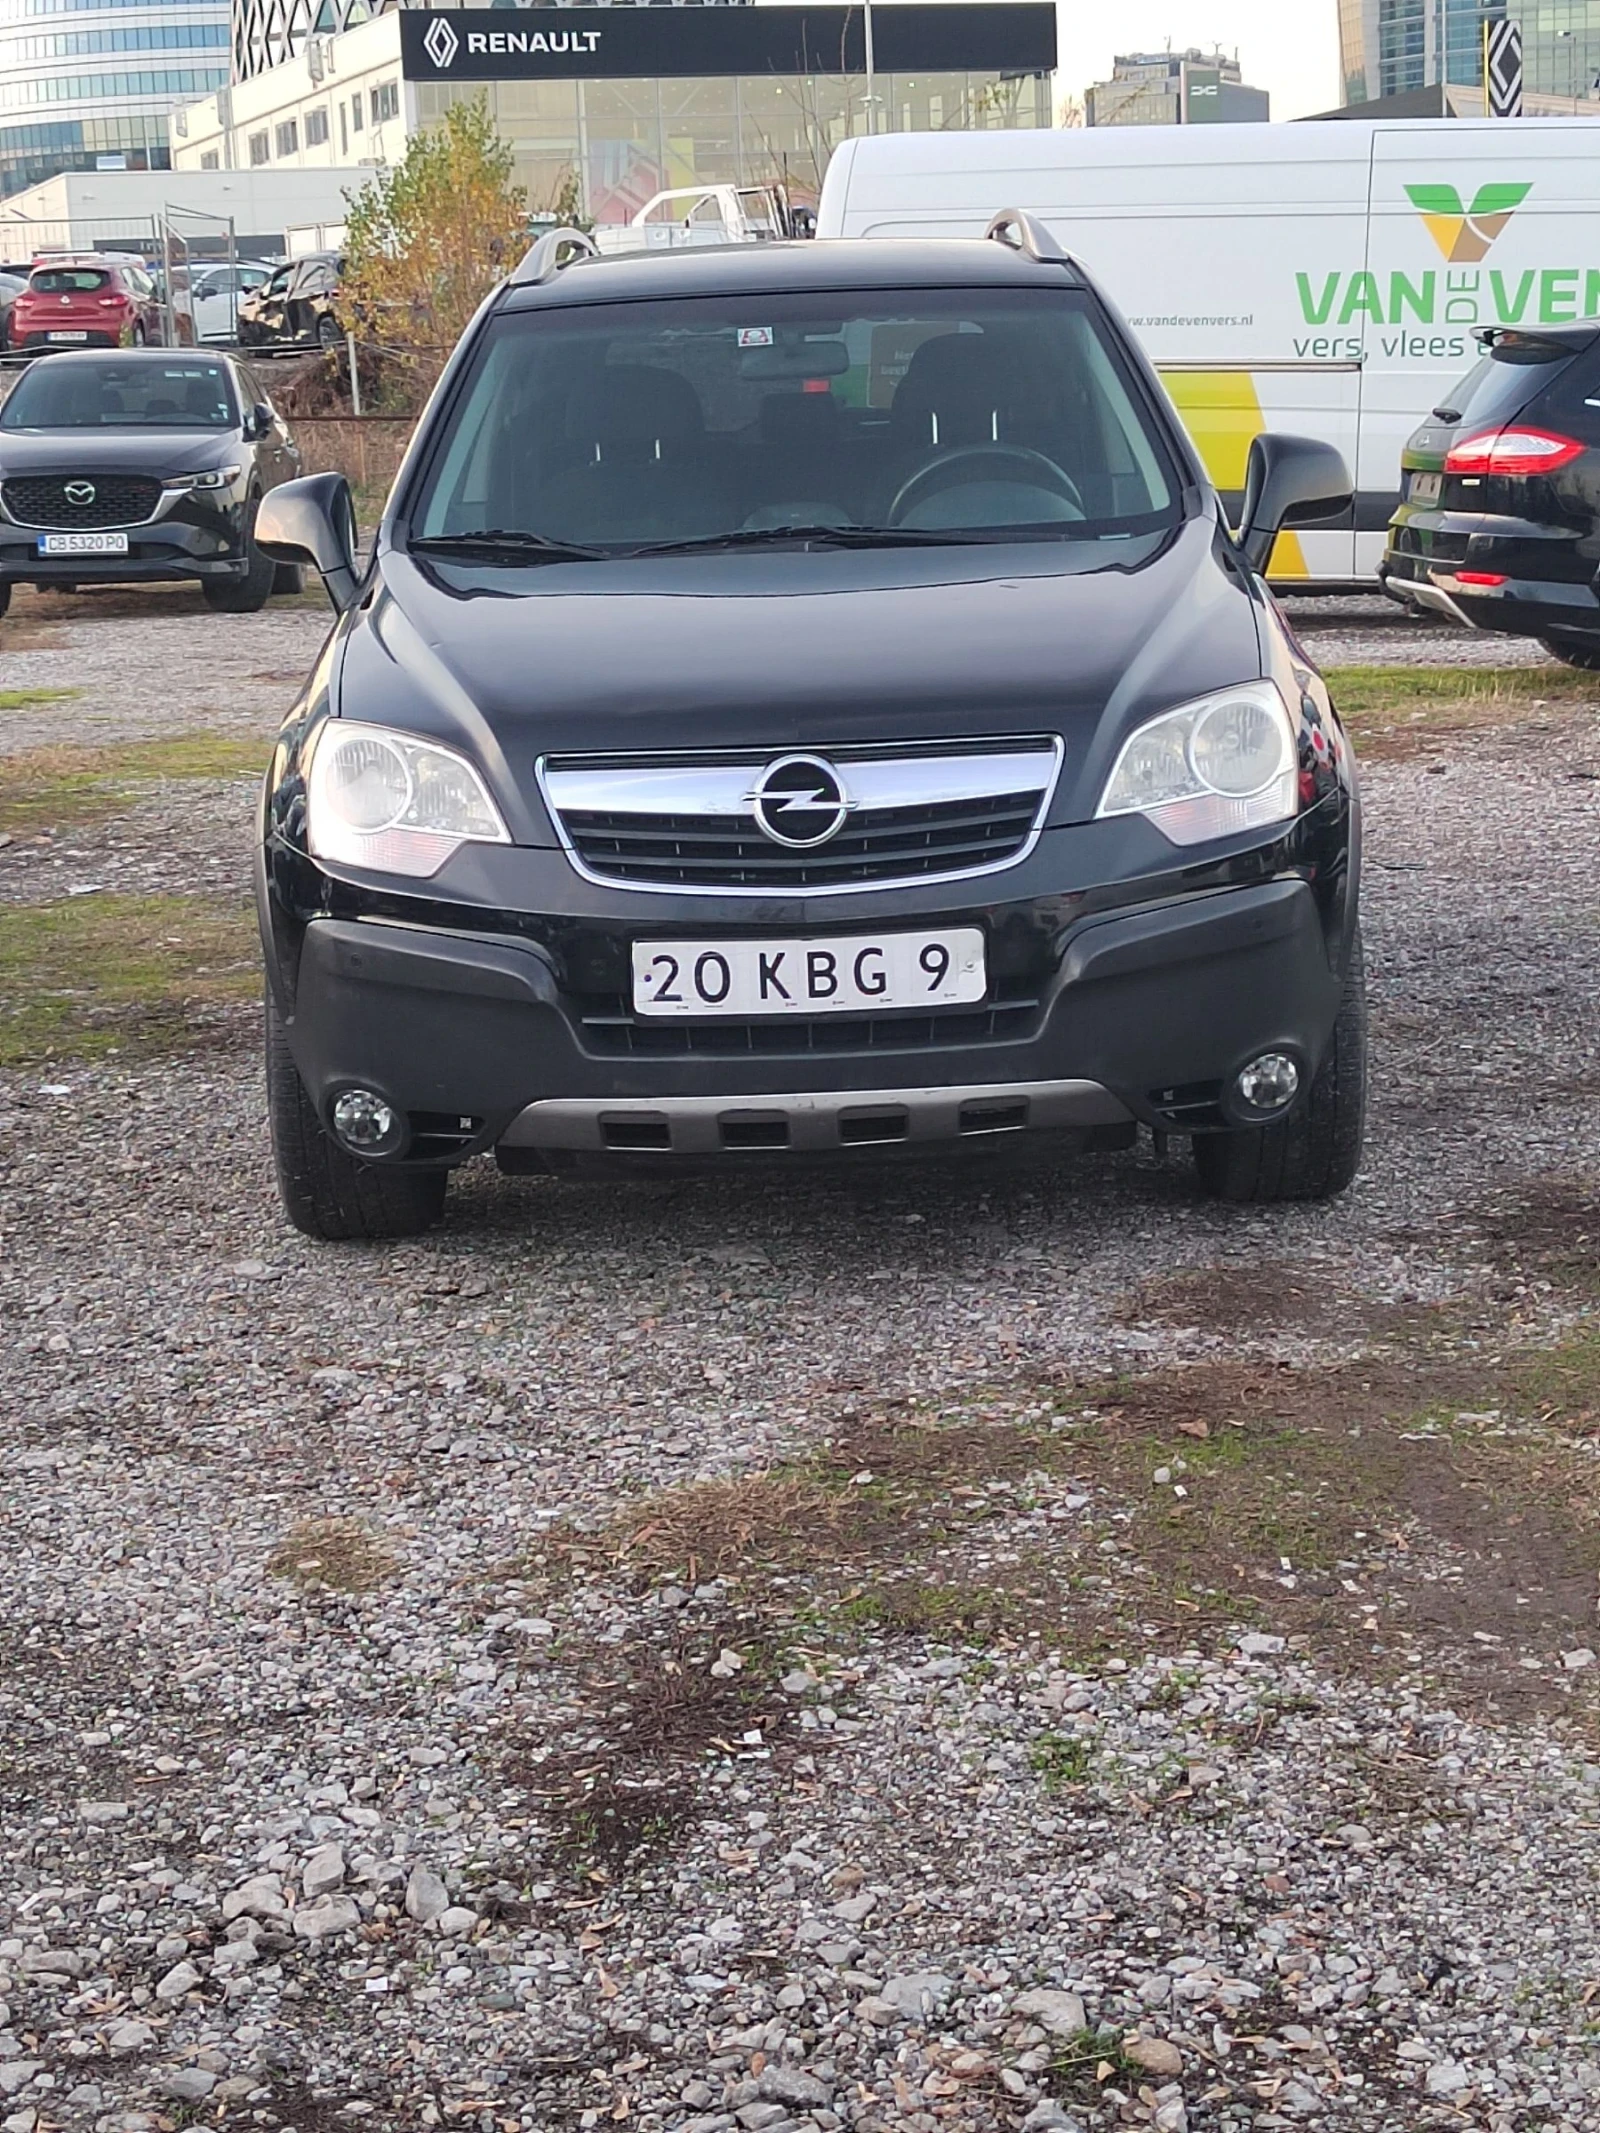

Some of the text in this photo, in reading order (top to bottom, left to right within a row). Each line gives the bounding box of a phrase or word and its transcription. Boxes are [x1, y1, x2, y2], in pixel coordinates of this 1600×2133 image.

[467, 31, 601, 54] RENAULT
[1295, 270, 1435, 325] VAN
[1446, 270, 1480, 324] DE
[1293, 336, 1369, 362] vers,
[1381, 329, 1464, 357] vlees
[49, 537, 66, 550] CB
[69, 536, 103, 550] 5320
[652, 943, 951, 1004] 20 KBG 9
